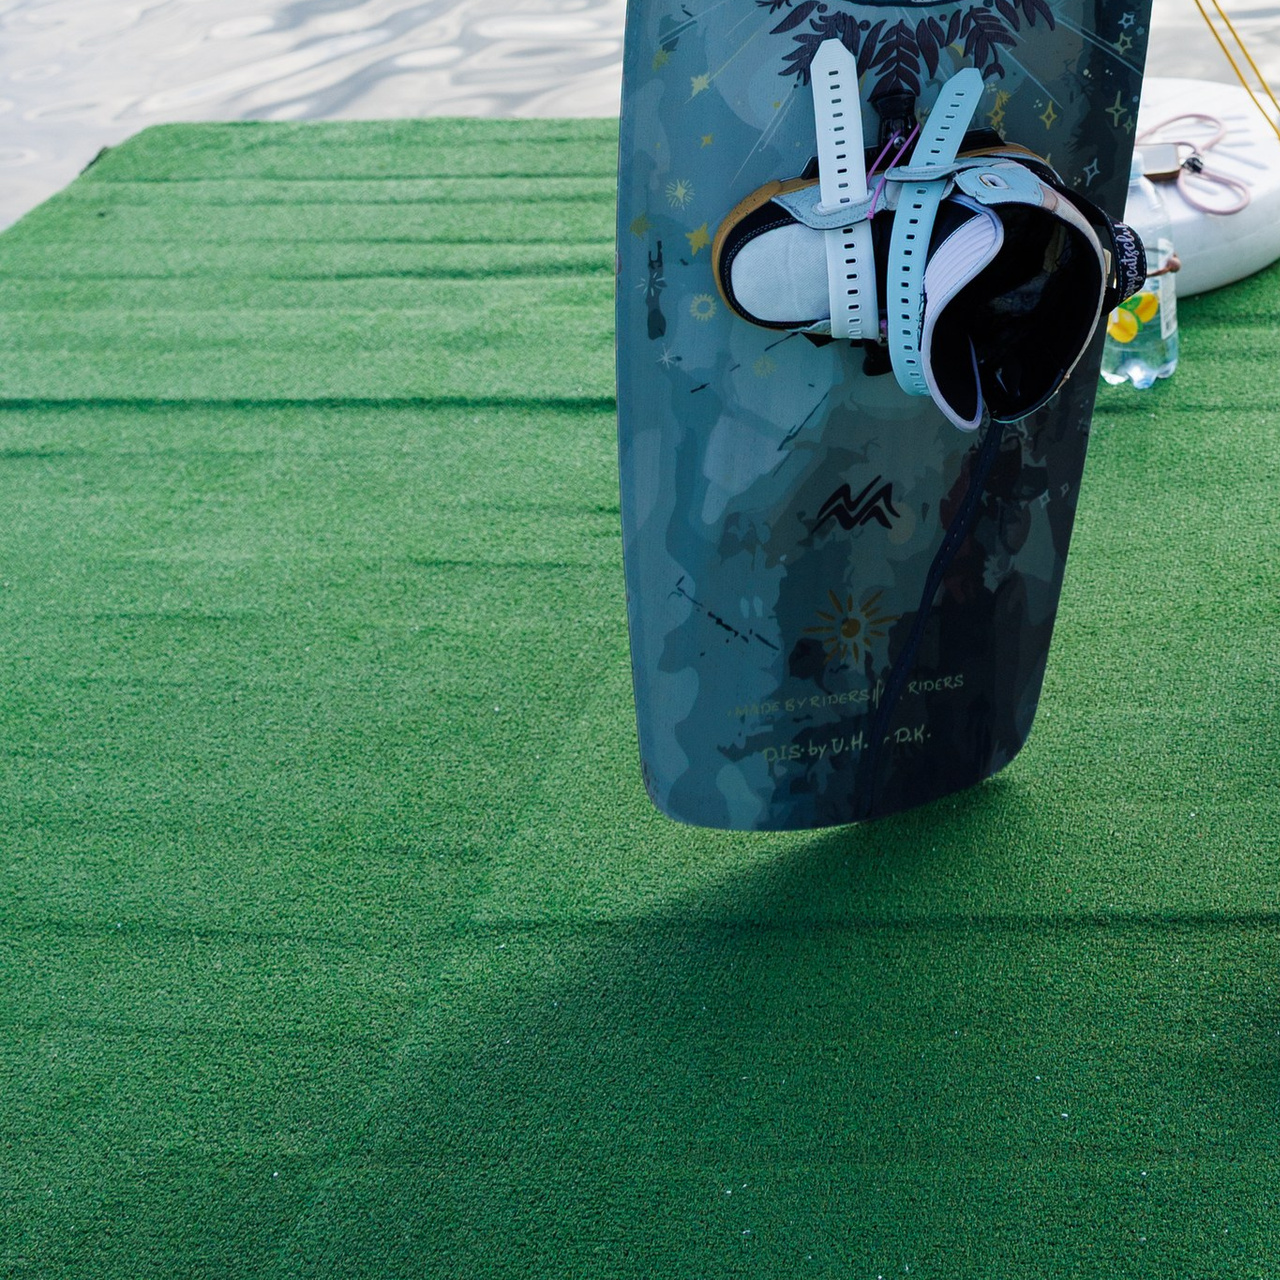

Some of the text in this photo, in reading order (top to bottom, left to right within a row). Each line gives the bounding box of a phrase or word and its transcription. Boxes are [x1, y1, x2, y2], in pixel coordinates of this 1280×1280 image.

[784, 696, 808, 713] BY
[809, 688, 871, 709] RIDERS
[907, 673, 965, 695] RIDERS
